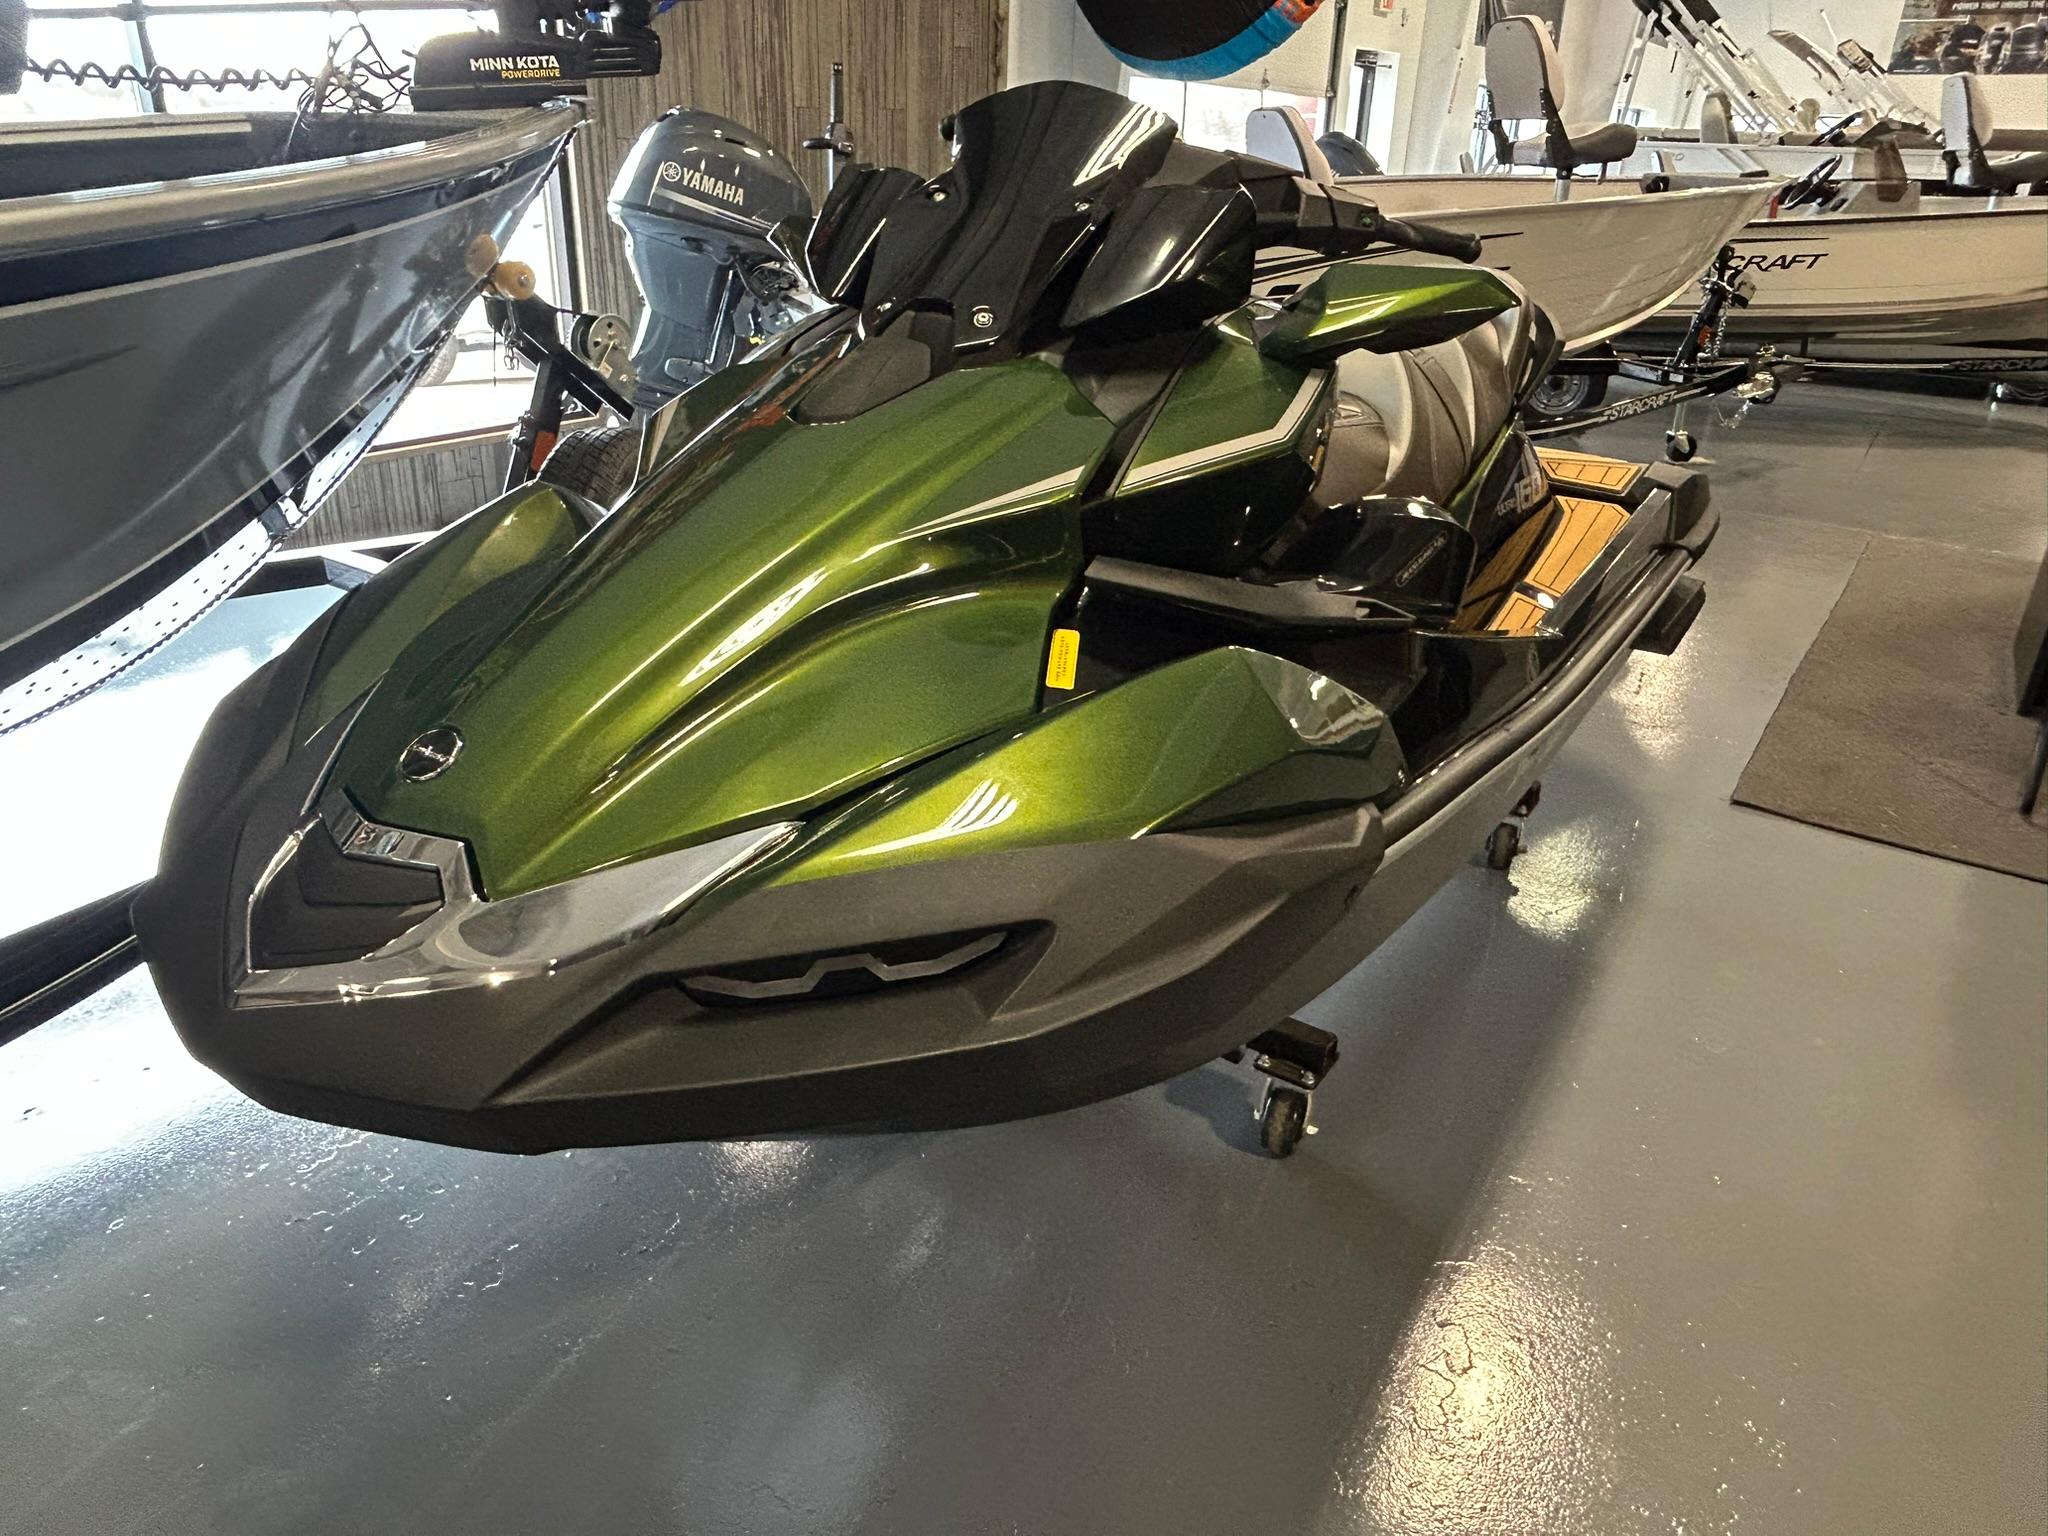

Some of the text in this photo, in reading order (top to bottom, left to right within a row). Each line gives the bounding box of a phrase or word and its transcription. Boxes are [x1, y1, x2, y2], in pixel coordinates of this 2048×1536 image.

[469, 55, 560, 71] MINN KOTA
[501, 68, 560, 79] POWERDRIVE
[682, 167, 745, 206] YAMAHA
[1728, 253, 1829, 272] CRAFT
[1608, 390, 1678, 420] STARCRAFT
